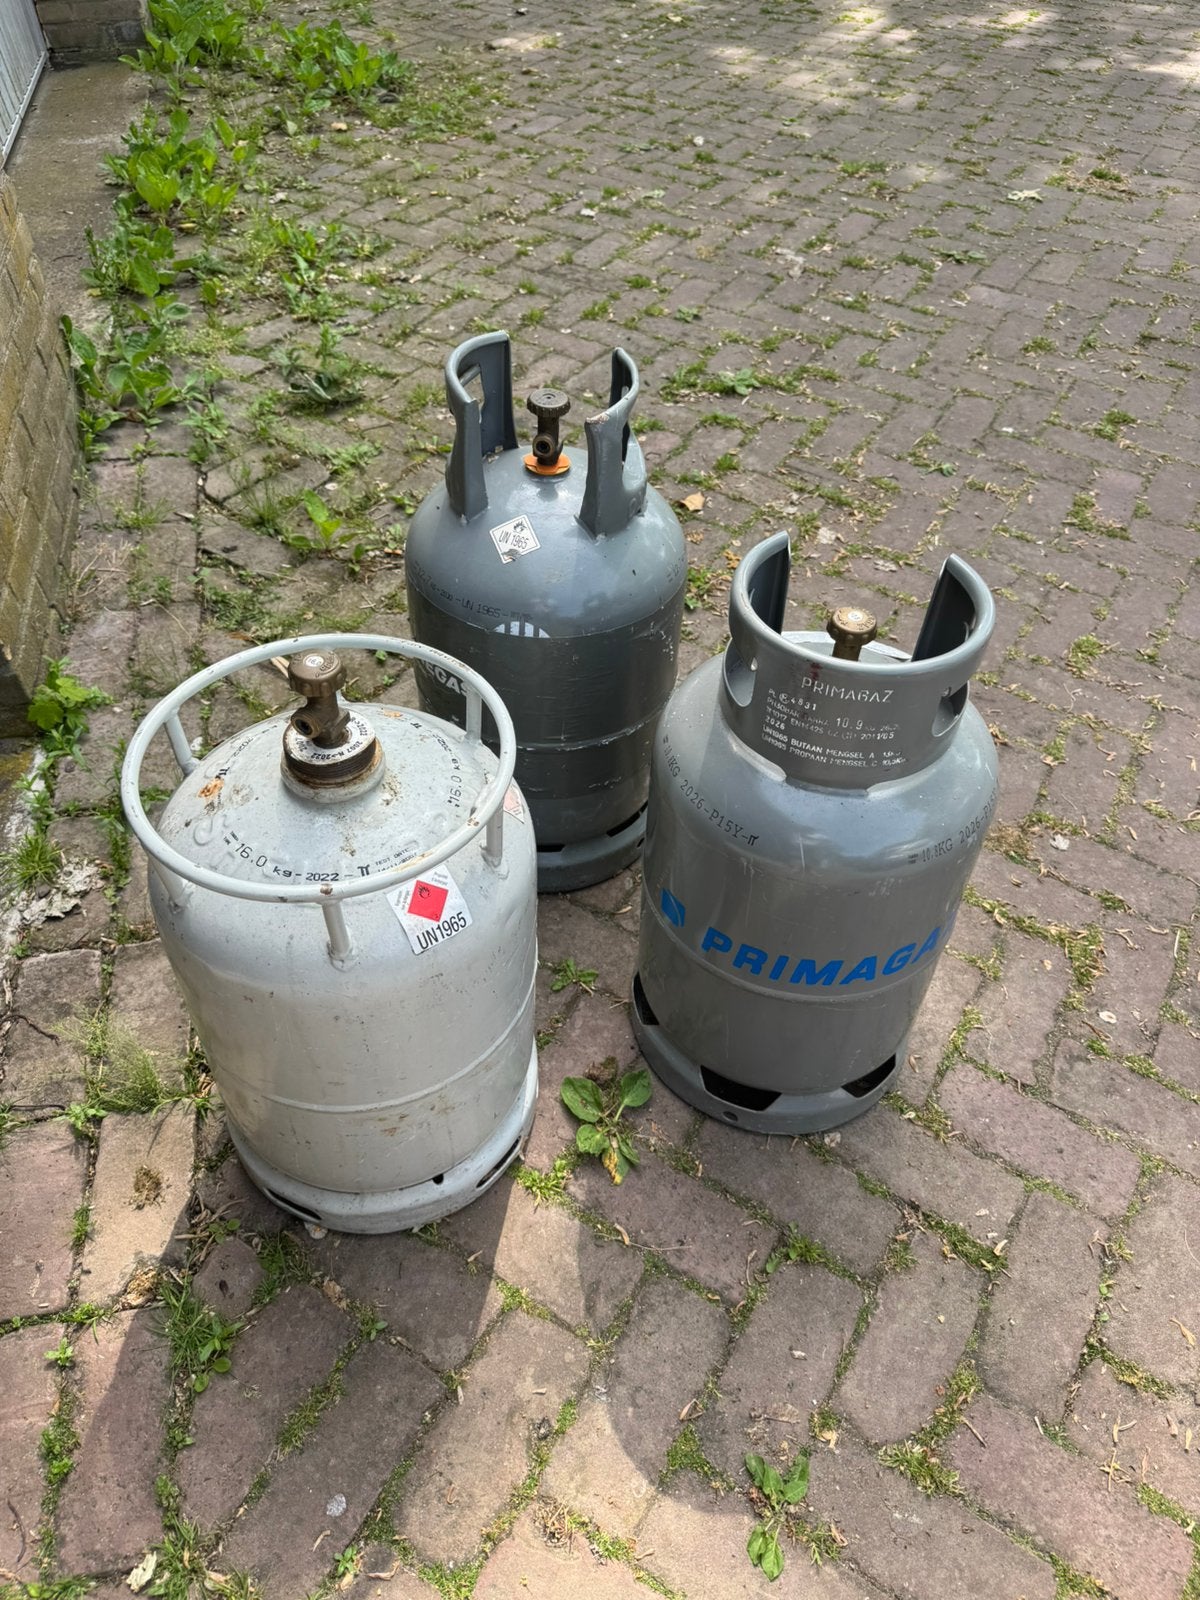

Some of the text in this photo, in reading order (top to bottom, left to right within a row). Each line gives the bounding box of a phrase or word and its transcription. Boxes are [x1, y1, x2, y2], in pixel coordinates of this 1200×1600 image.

[498, 530, 528, 549] UN 1965
[801, 677, 894, 703] PRIMAGAZ
[765, 715, 786, 730] 2026
[789, 746, 827, 763] PROPAAN
[791, 738, 823, 753] BUTAAN
[826, 748, 865, 759] MENGSEL
[417, 911, 467, 950] UN1965
[702, 912, 957, 986] PRIMAGA
